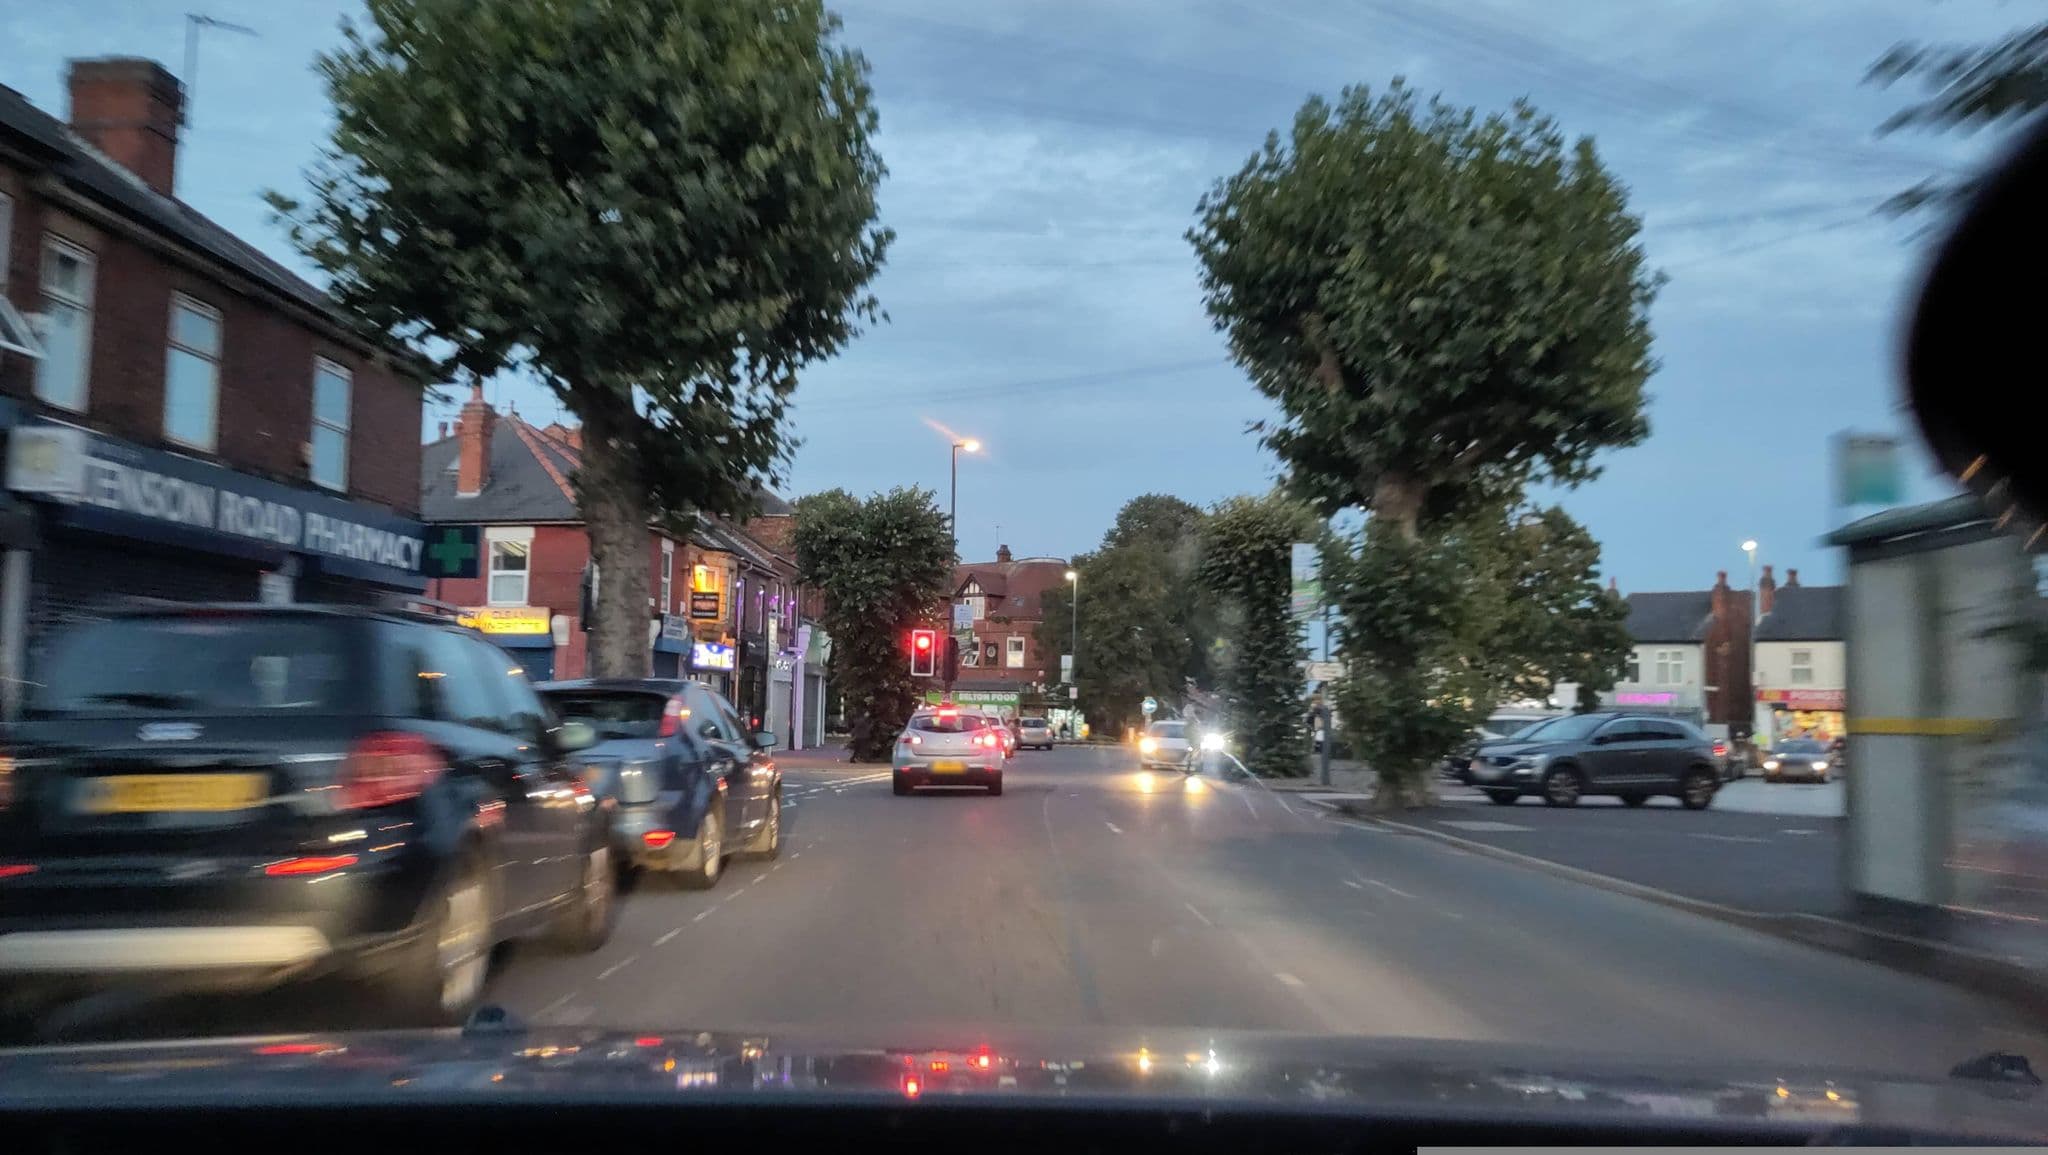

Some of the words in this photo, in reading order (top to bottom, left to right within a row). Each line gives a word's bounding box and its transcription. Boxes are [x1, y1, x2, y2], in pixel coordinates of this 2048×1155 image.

[219, 490, 300, 545] ROAD
[305, 512, 424, 571] PHARMACY
[991, 693, 1018, 702] FOOD
